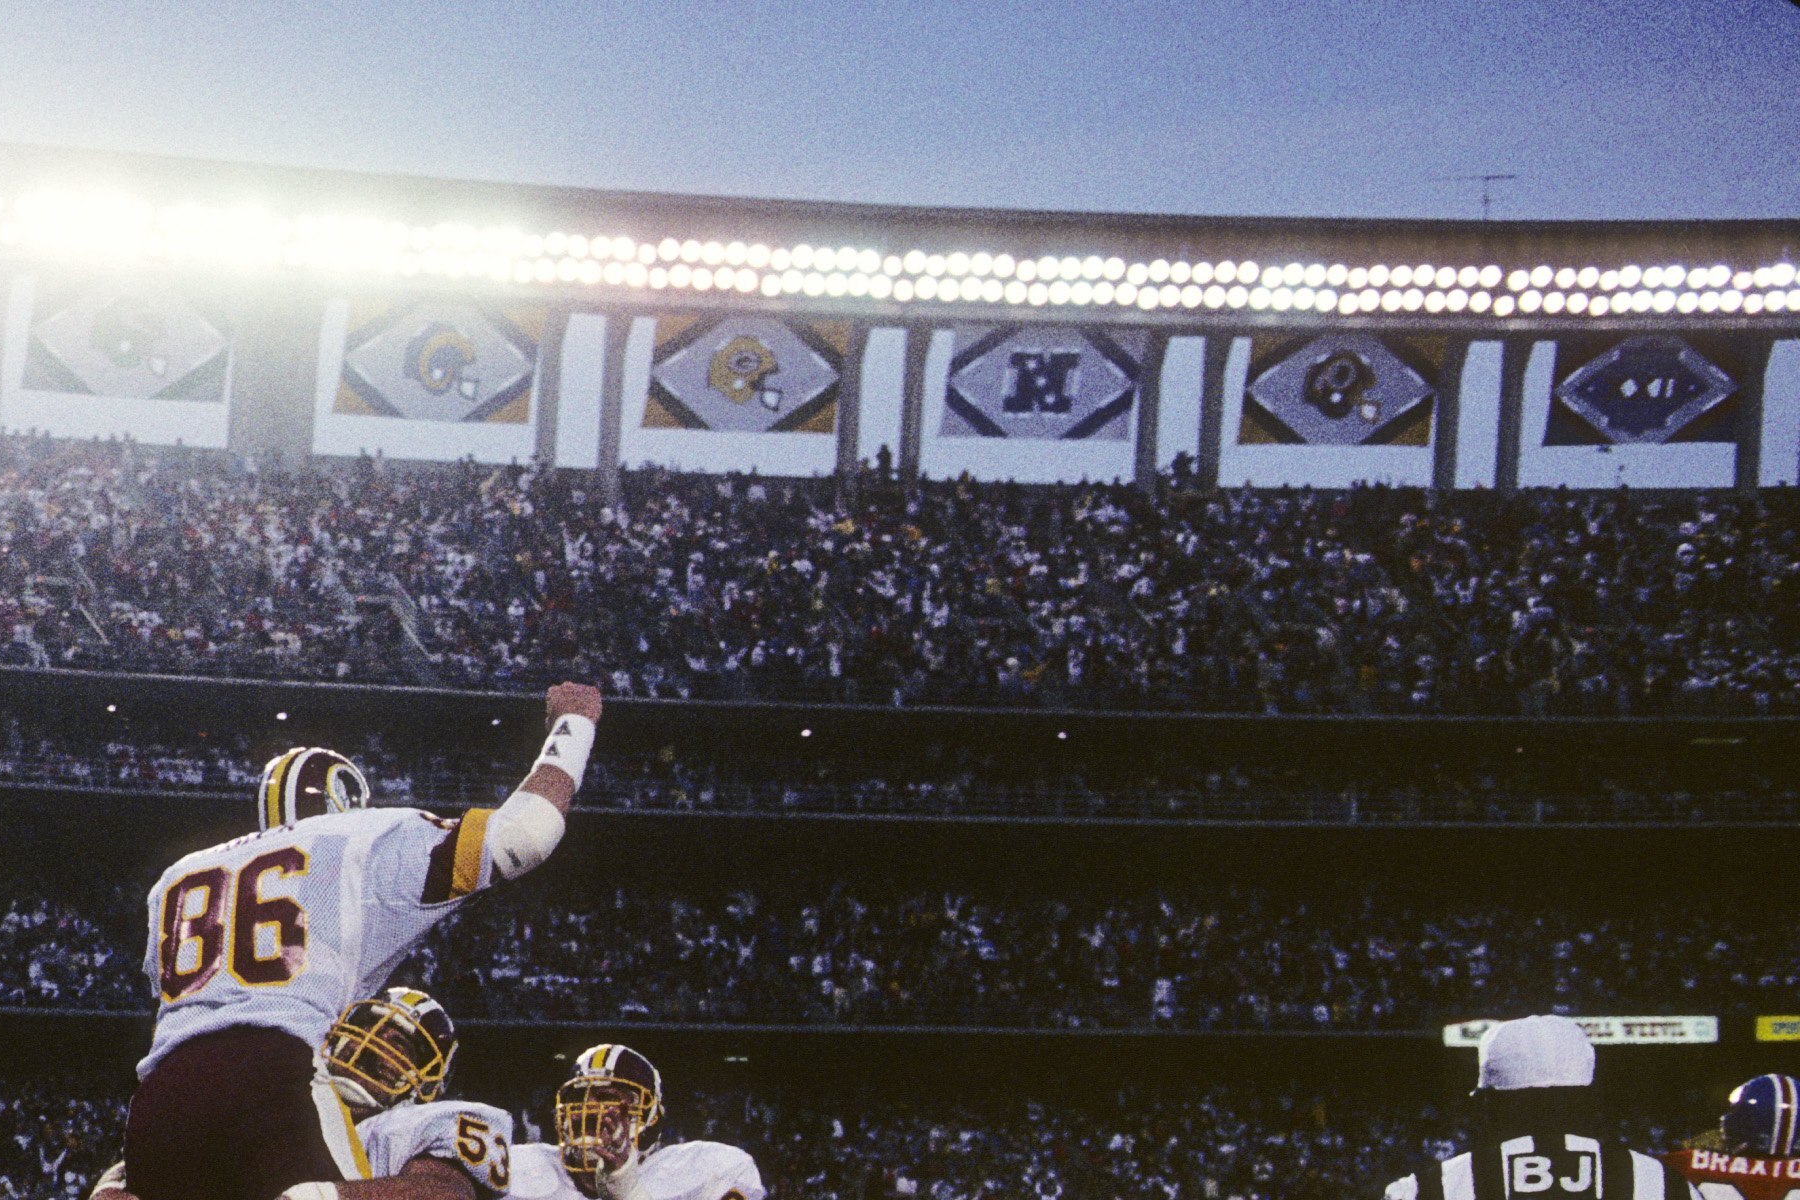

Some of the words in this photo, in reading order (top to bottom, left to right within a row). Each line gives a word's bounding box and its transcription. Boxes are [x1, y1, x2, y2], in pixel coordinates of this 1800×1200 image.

[160, 846, 309, 1003] 86
[456, 1112, 511, 1190] 53
[1513, 1155, 1592, 1192] BJ
